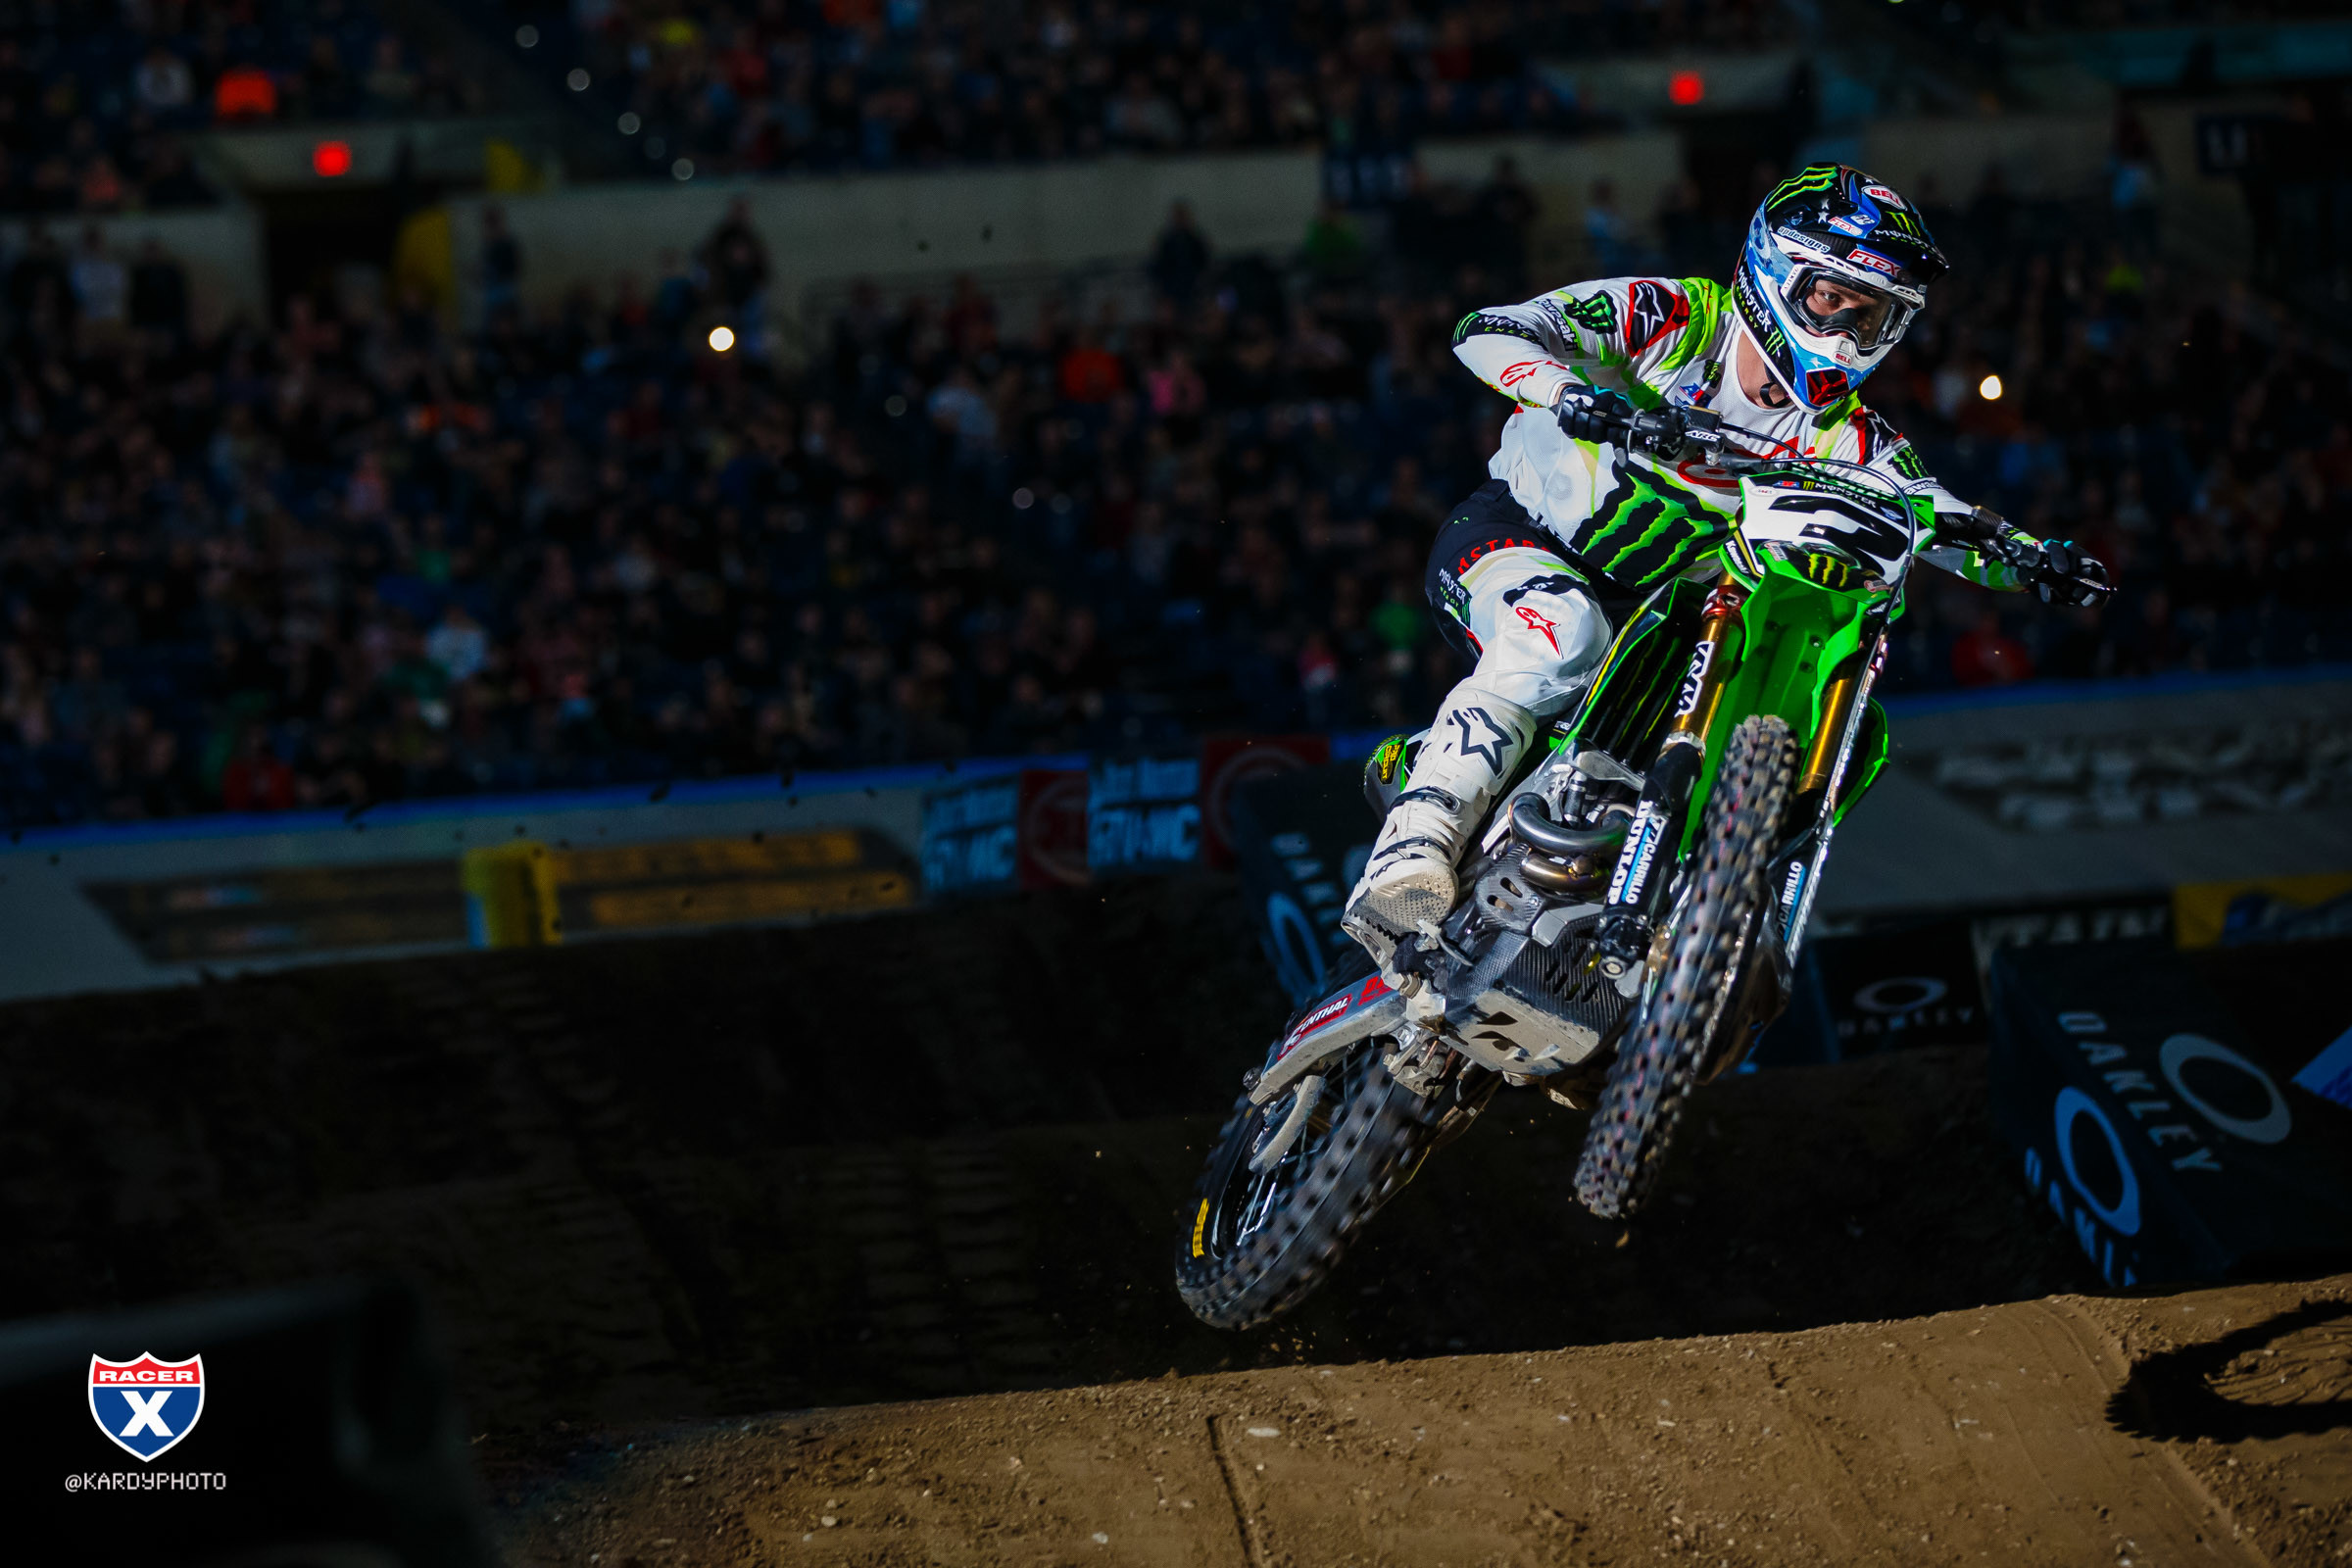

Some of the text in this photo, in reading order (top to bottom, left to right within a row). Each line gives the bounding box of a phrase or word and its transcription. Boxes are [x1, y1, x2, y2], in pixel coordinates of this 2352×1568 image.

[1777, 226, 1832, 253] apdesigns
[1830, 218, 1854, 232] FLEX
[1847, 249, 1902, 278] FLEX
[1835, 353, 1852, 366] BELL
[1685, 430, 1721, 442] ARC
[1815, 482, 1877, 509] MONSTER
[1382, 745, 1393, 780] CIRCUIT
[1390, 744, 1400, 761] PRO
[1607, 800, 1653, 906] DUNLOP
[1625, 843, 1656, 905] CARRILLO
[1778, 861, 1803, 921] CARRILLO
[1279, 997, 1348, 1055] RENTHAL
[2058, 1010, 2223, 1172] OAKLEY
